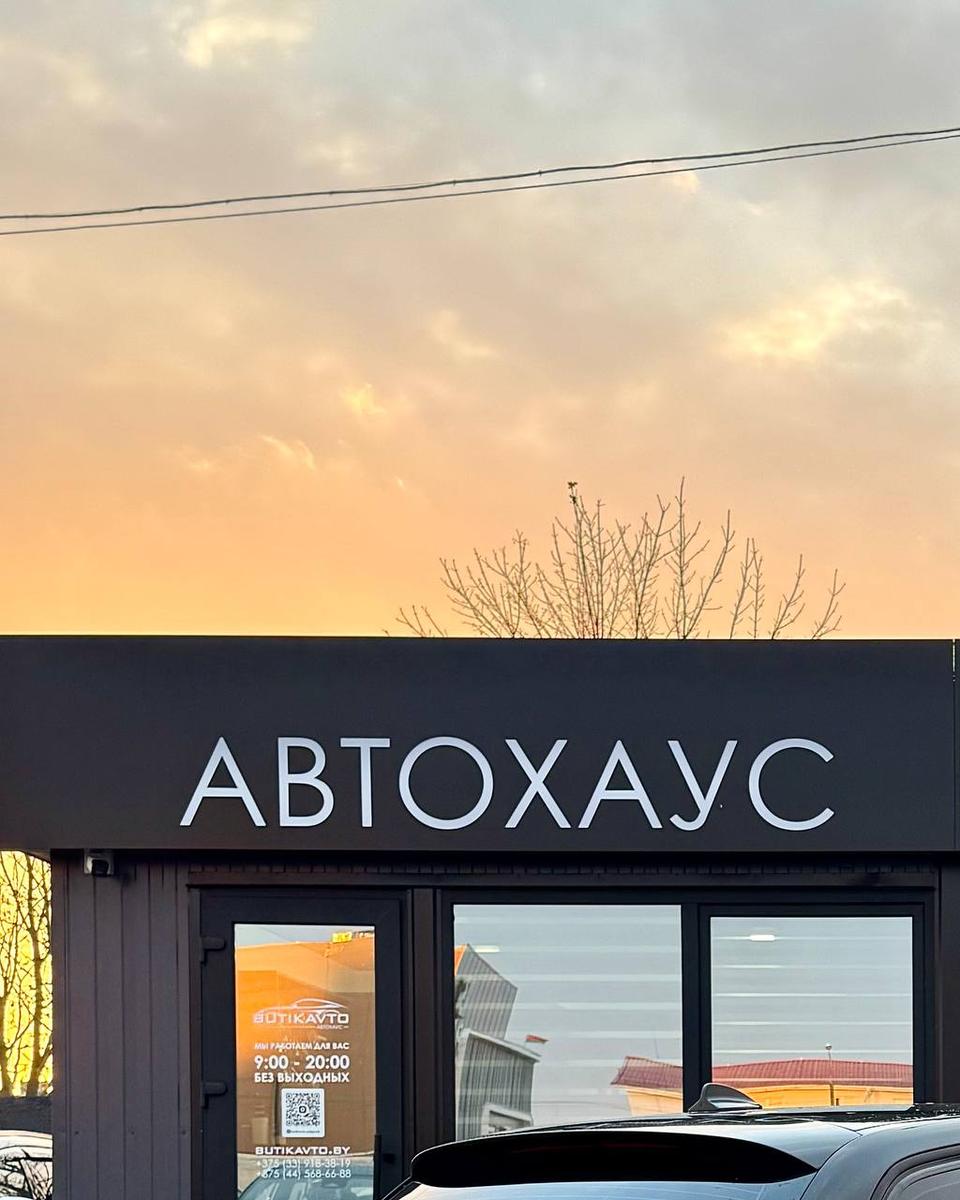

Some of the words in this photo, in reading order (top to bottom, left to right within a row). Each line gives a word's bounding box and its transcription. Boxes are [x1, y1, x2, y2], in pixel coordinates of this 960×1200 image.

[180, 736, 835, 832] АВТОХАУС
[253, 1013, 350, 1025] BUTIKAVTO
[332, 1042, 350, 1051] ВАС
[254, 1055, 289, 1070] 9:00
[305, 1055, 350, 1070] 20:00
[254, 1072, 274, 1083] БЕЗ
[277, 1072, 350, 1084] ВЫХОДНЫХ
[255, 1146, 351, 1155] BUTIKAVTO.BY
[304, 1159, 351, 1168] 918-38-19
[283, 1168, 300, 1180] (44)
[304, 1169, 352, 1178] 568-66-88
